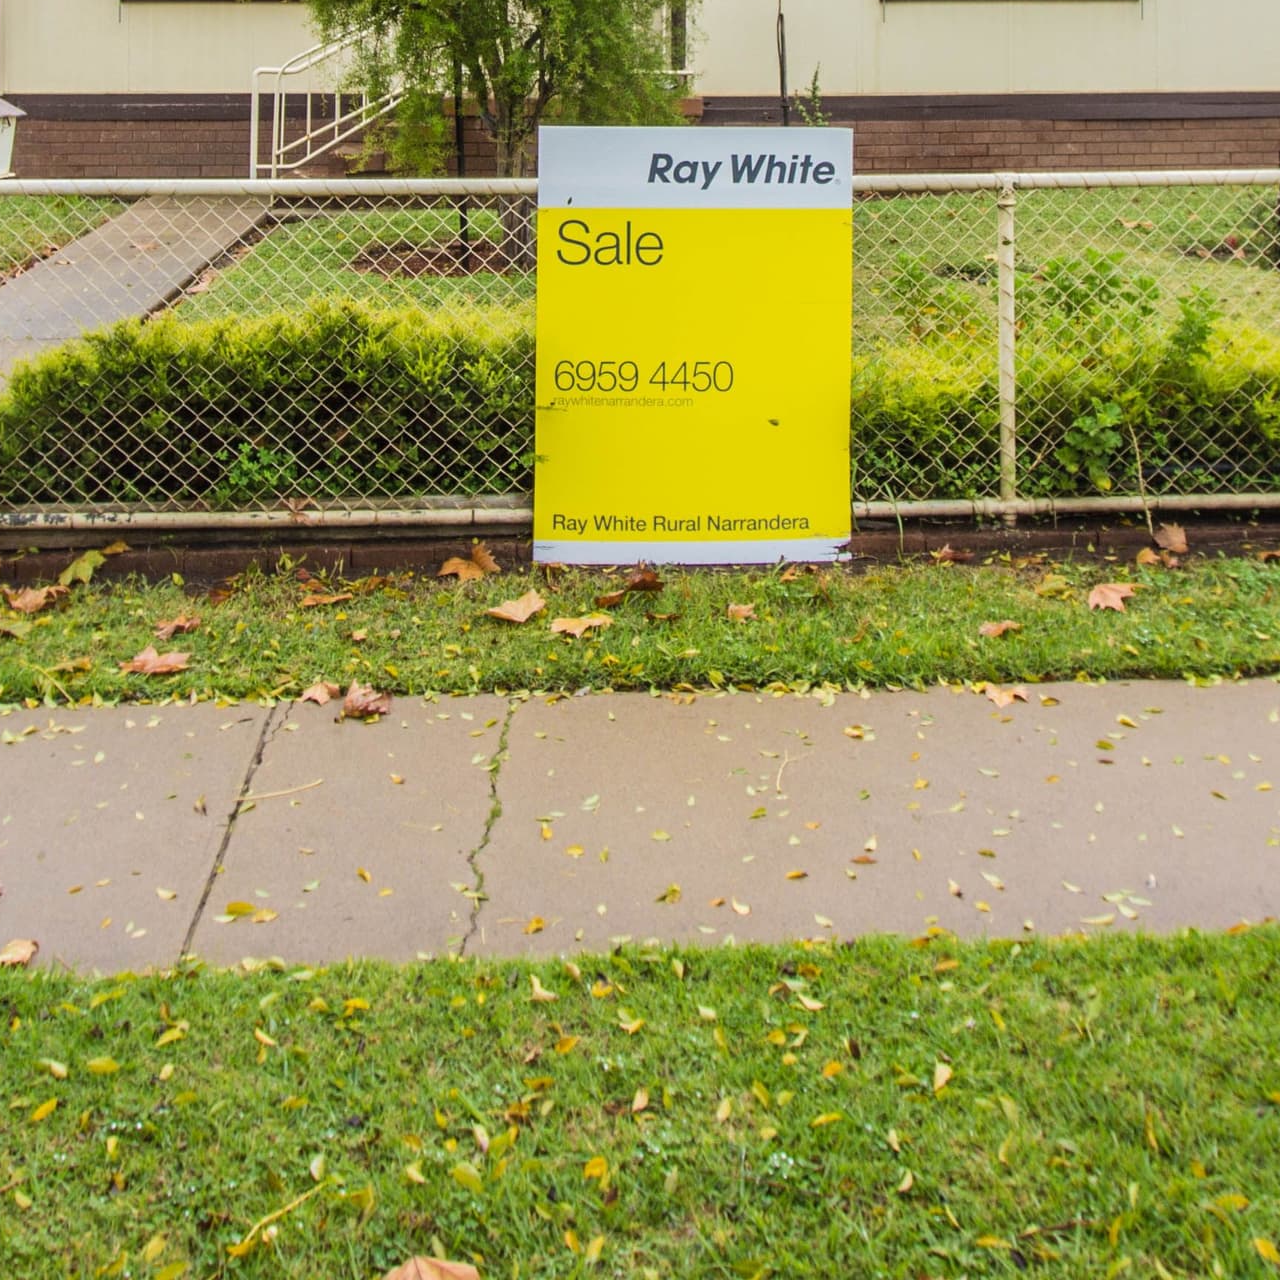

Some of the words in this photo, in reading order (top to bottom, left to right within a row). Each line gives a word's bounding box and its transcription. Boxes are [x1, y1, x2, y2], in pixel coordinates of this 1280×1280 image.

[647, 152, 723, 191] Ray
[730, 153, 836, 185] White
[556, 219, 664, 266] Sale
[554, 359, 639, 392] 6959
[648, 360, 734, 392] 4450
[552, 513, 588, 535] Ray
[593, 514, 647, 532] White
[652, 514, 701, 532] Rural
[707, 513, 810, 532] Narrandera
